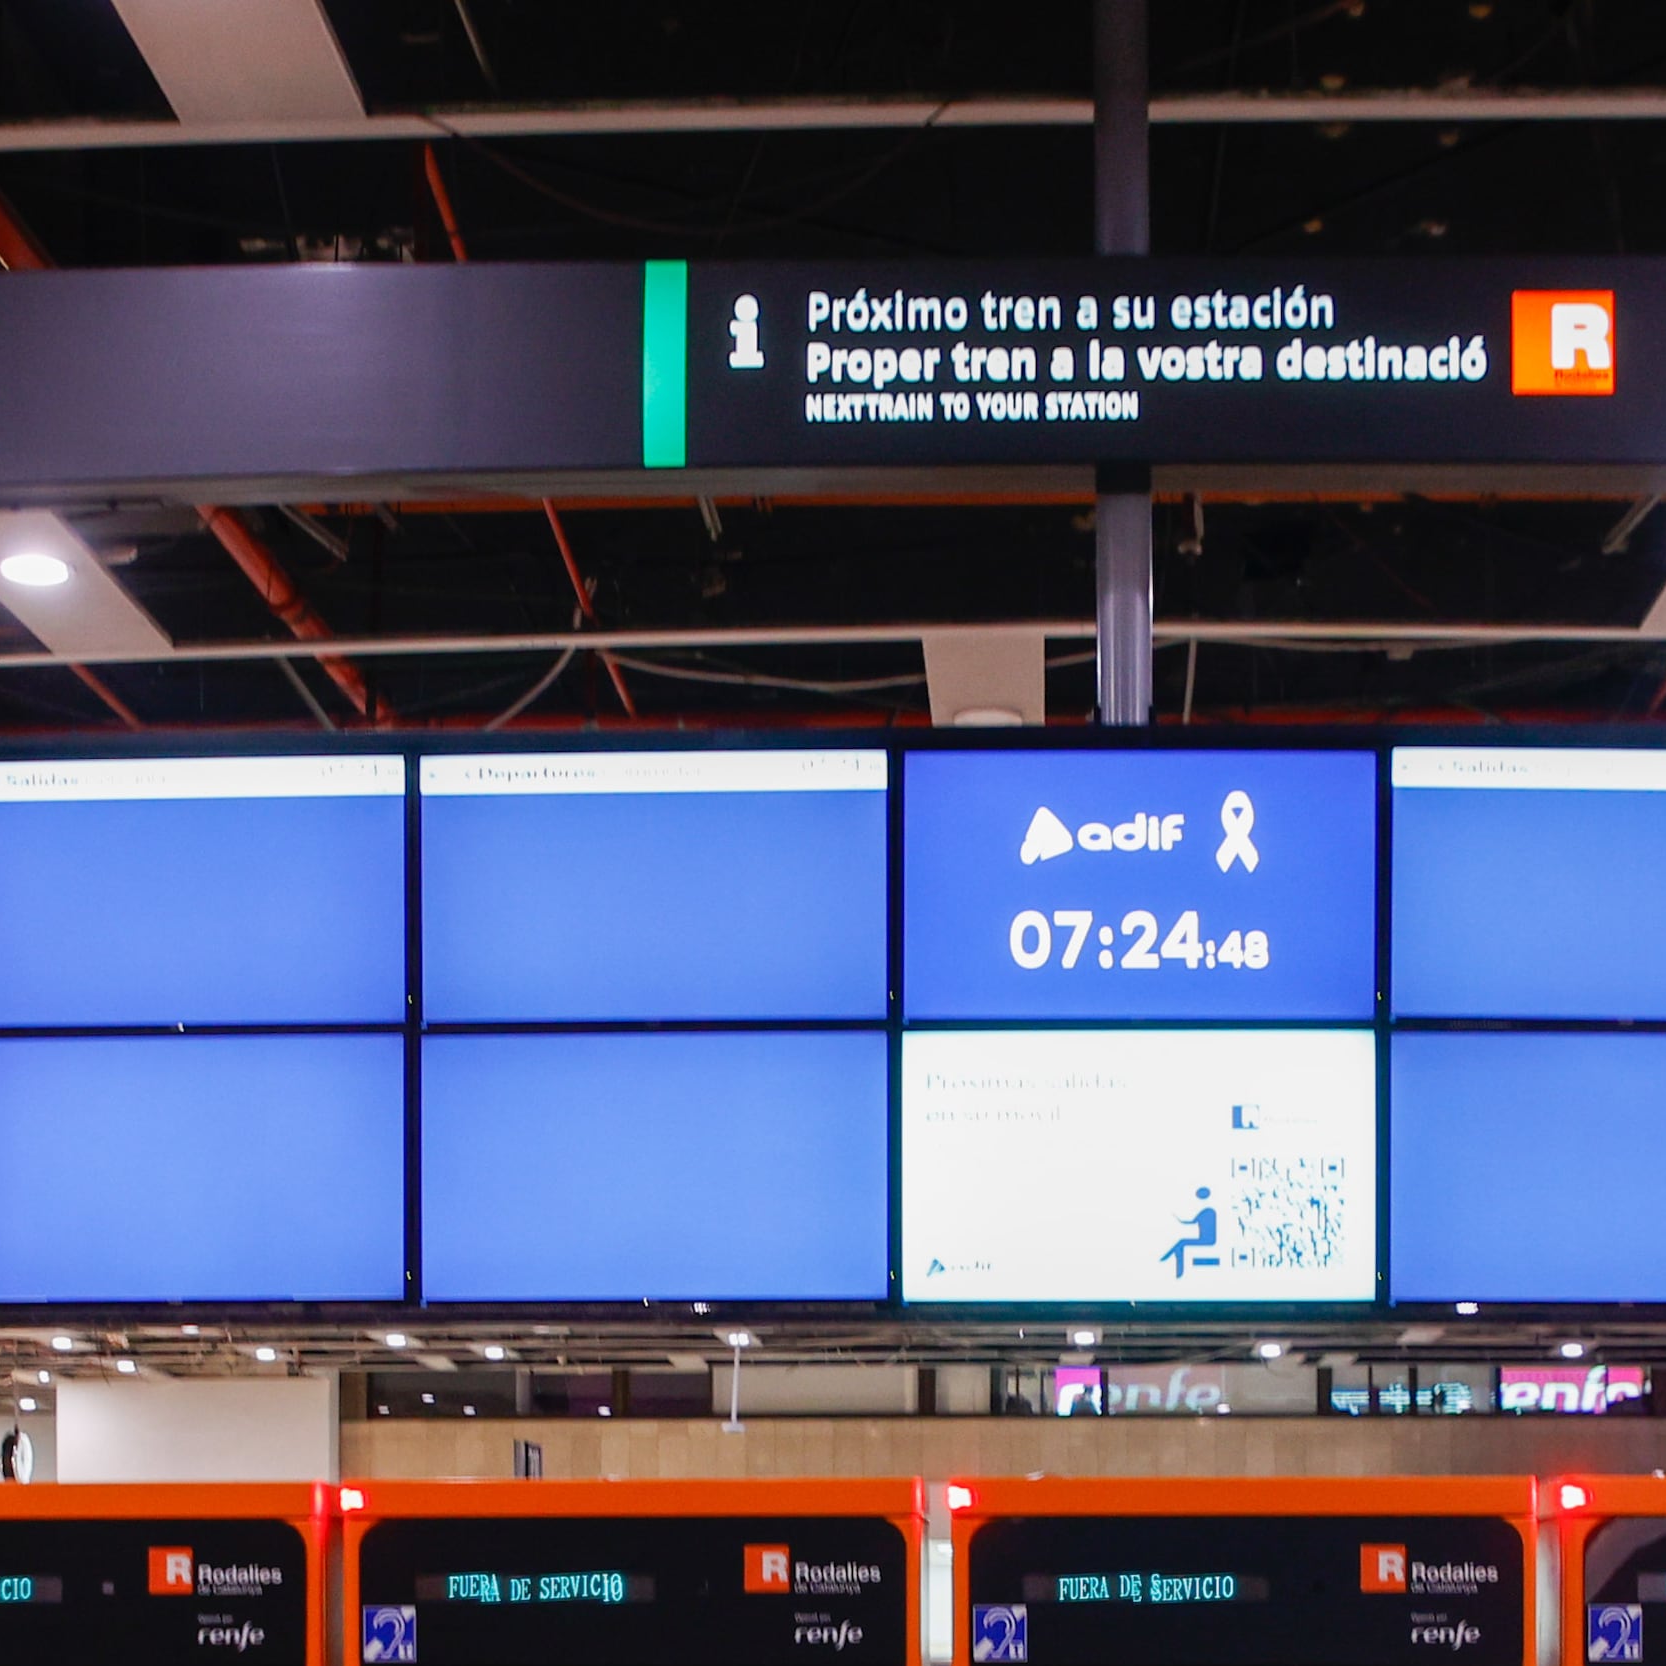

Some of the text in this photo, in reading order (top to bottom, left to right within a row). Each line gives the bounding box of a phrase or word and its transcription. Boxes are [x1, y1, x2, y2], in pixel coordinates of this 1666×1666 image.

[808, 285, 1334, 331] Próximo tren a su estación
[807, 335, 1487, 389] Proper tren a la vostra destinació
[940, 393, 971, 421] TO
[975, 393, 1039, 421] YOUR
[1044, 392, 1139, 421] STATION
[1077, 813, 1185, 851] adif
[166, 1554, 193, 1585] R
[197, 1563, 283, 1585] Rodalies
[762, 1552, 788, 1583] R
[795, 1561, 881, 1583] Rodalies
[1377, 1552, 1405, 1583] R
[1411, 1561, 1499, 1584] Rodalies
[448, 1572, 624, 1602] FUERA DE SERVICIO
[1058, 1573, 1234, 1602] FUERA DE SERVICIO
[197, 1620, 265, 1652] renfe
[794, 1618, 863, 1651] renfe
[1410, 1618, 1481, 1652] renfe
